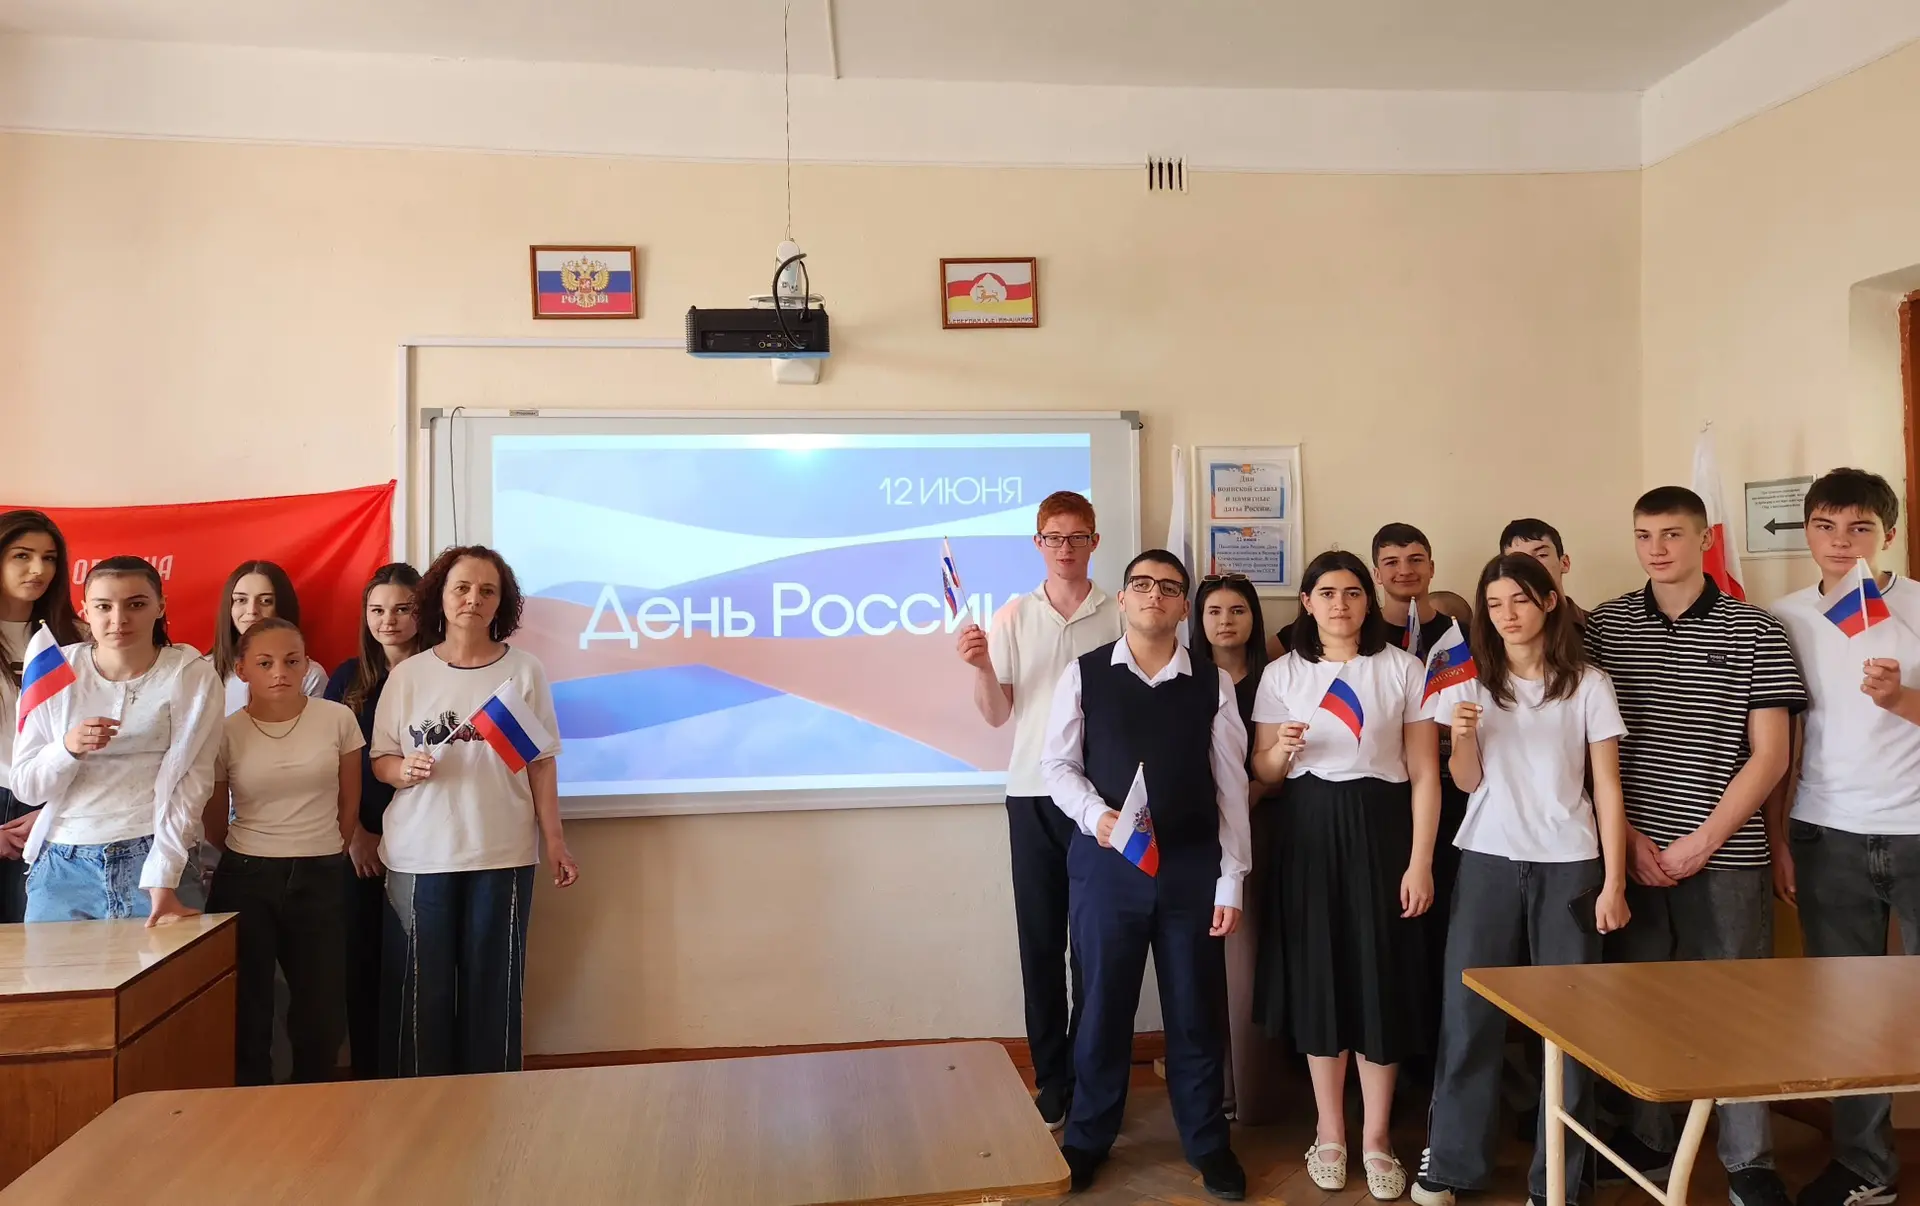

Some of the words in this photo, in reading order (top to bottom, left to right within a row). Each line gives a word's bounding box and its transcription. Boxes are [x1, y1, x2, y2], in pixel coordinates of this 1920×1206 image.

[879, 477, 912, 505] 12
[919, 476, 1022, 505] ИЮНЯ
[579, 585, 755, 650] День
